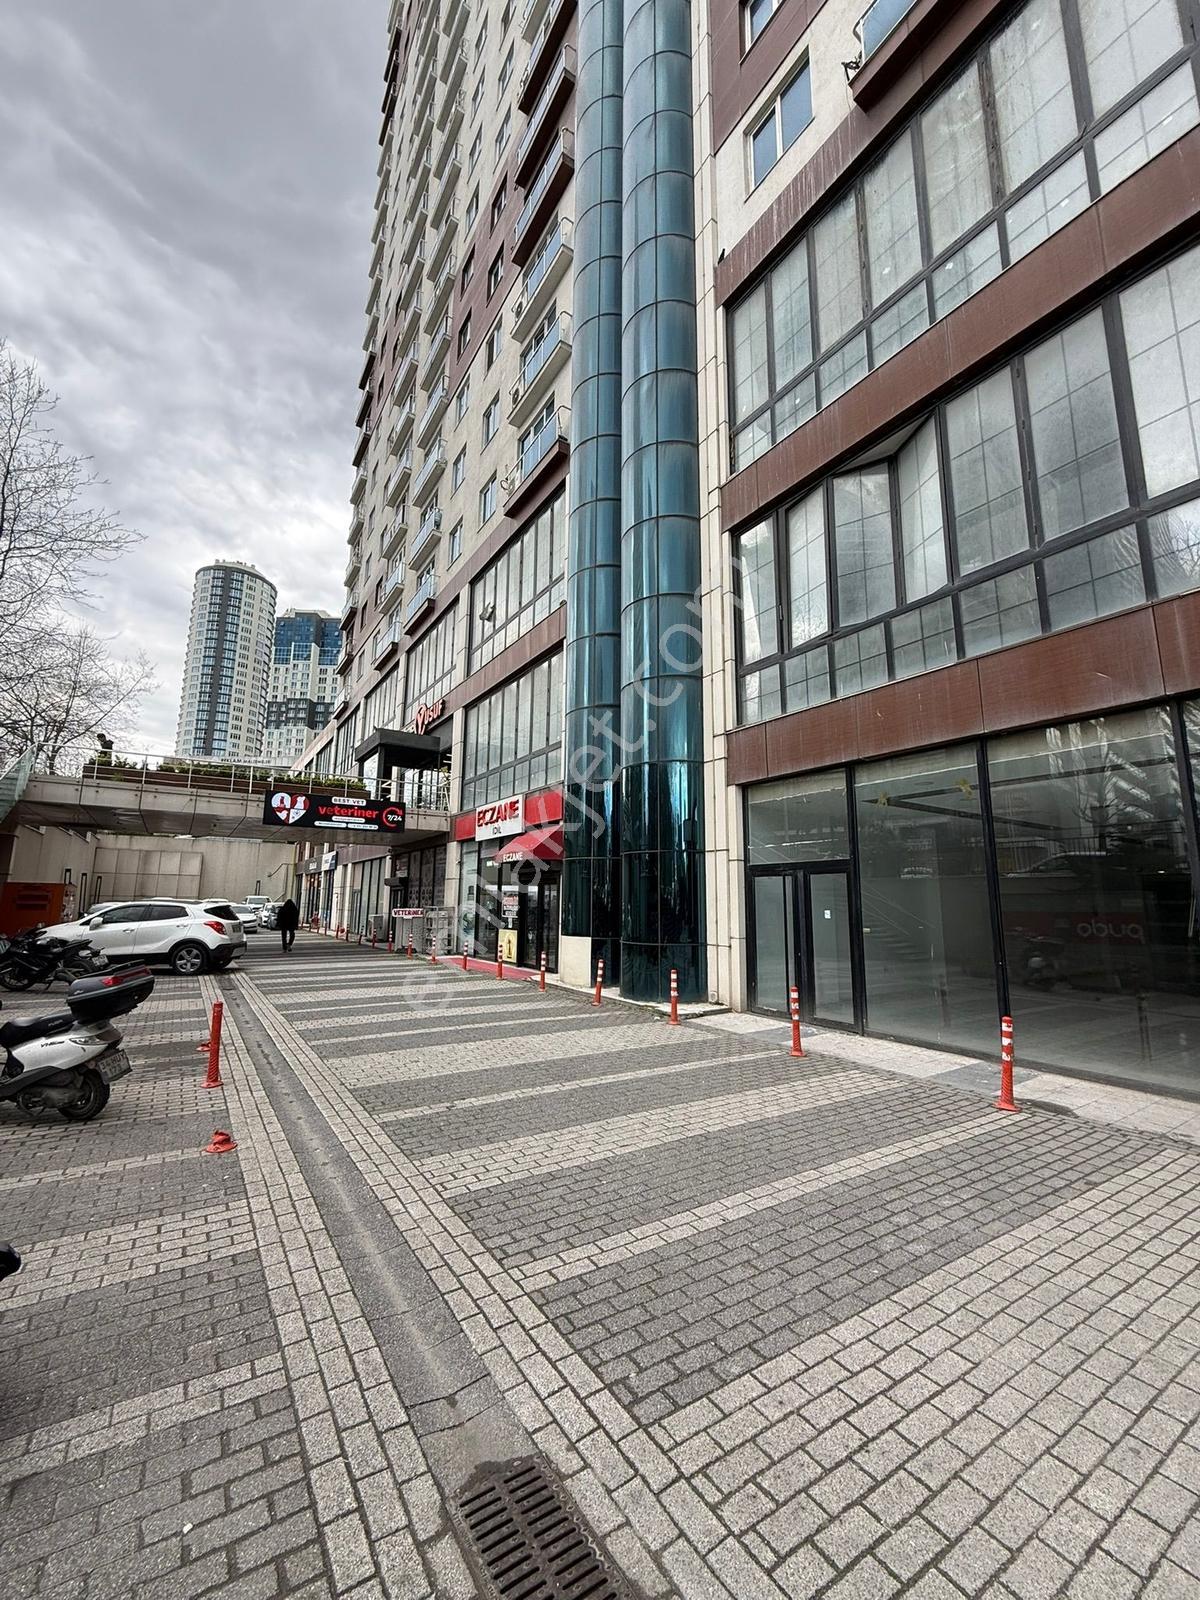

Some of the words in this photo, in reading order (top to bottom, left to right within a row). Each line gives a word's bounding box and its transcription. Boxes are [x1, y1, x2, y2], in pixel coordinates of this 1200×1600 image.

[318, 805, 379, 819] veteriner
[386, 814, 403, 822] 7/24
[476, 799, 520, 827] ECZANE
[502, 852, 524, 863] ECZANE
